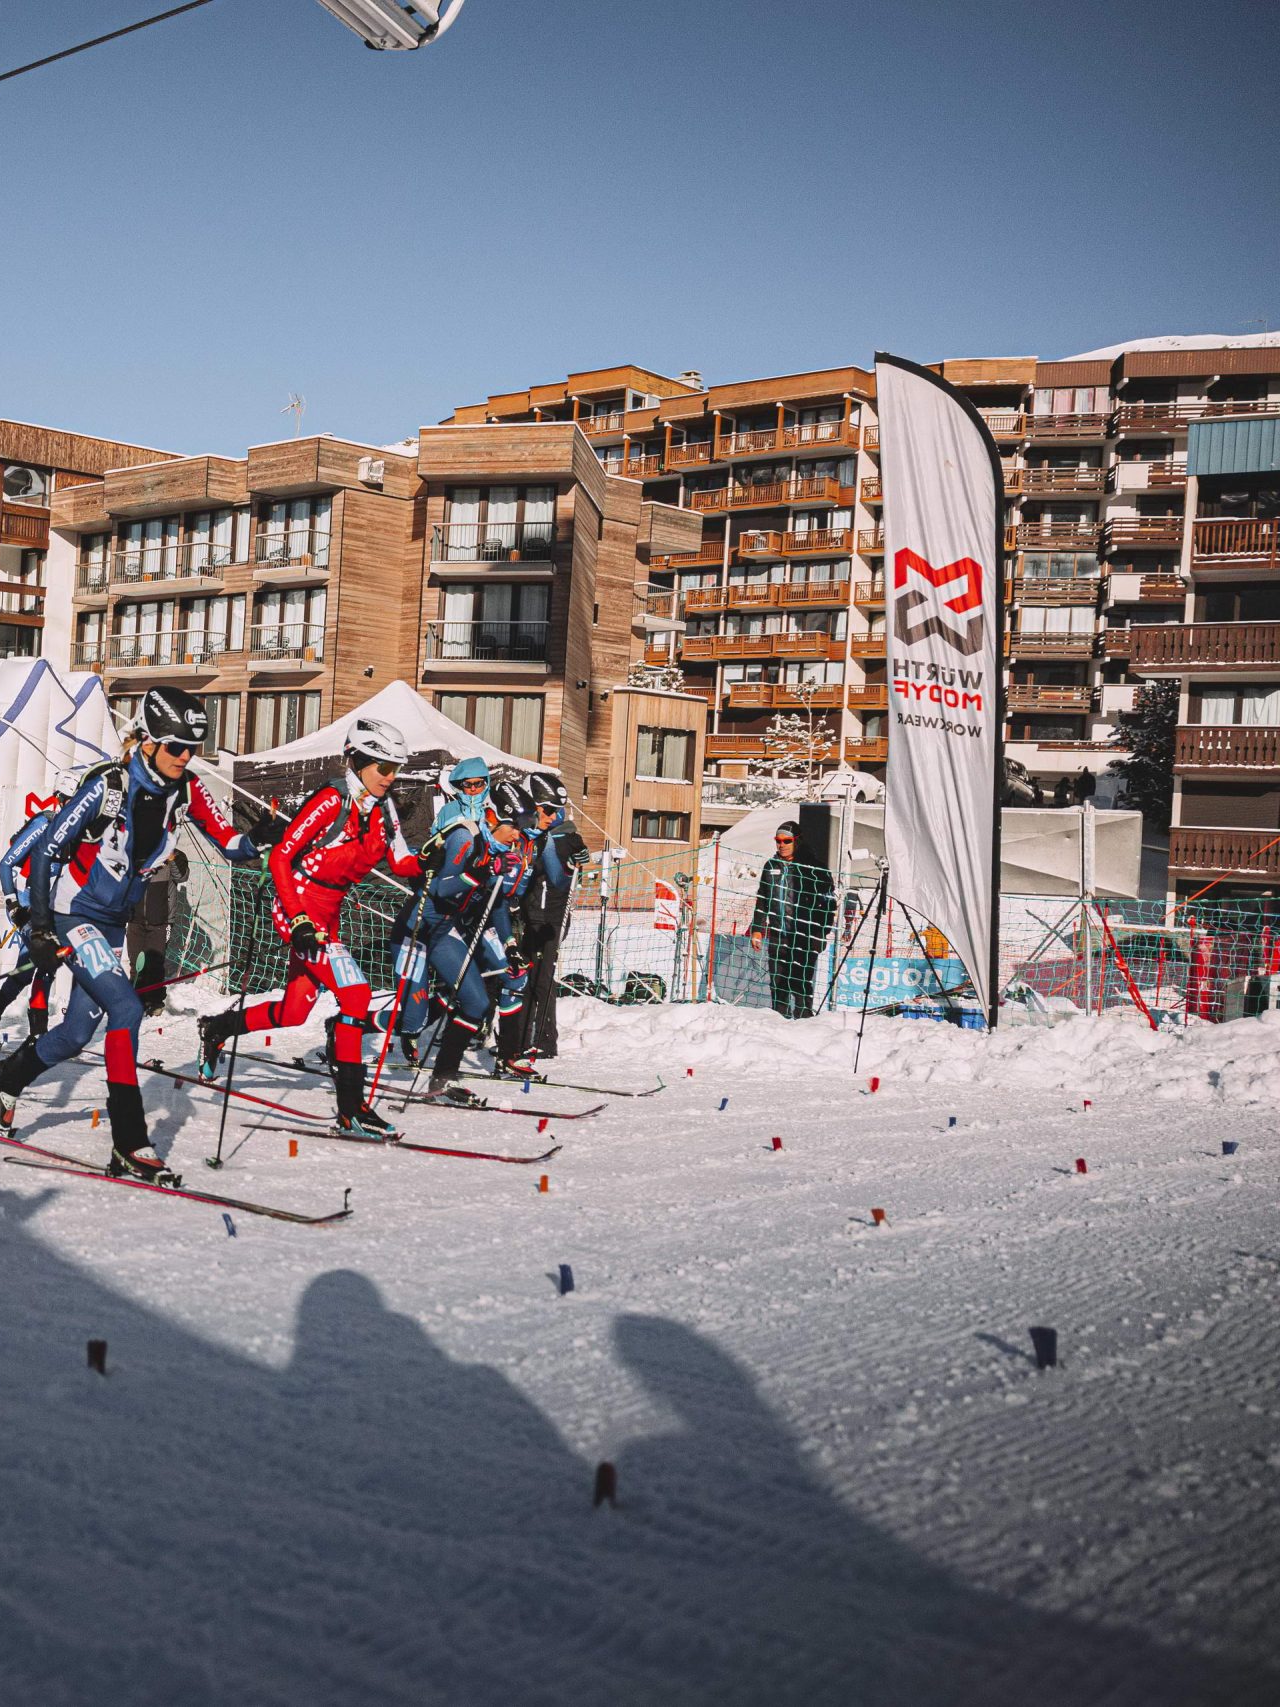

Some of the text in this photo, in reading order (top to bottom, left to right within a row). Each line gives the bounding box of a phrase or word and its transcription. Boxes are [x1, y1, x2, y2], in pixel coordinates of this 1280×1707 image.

[53, 781, 104, 843] SPORTIVA
[195, 779, 230, 830] FRANCE
[292, 795, 341, 841] SPORTIVA
